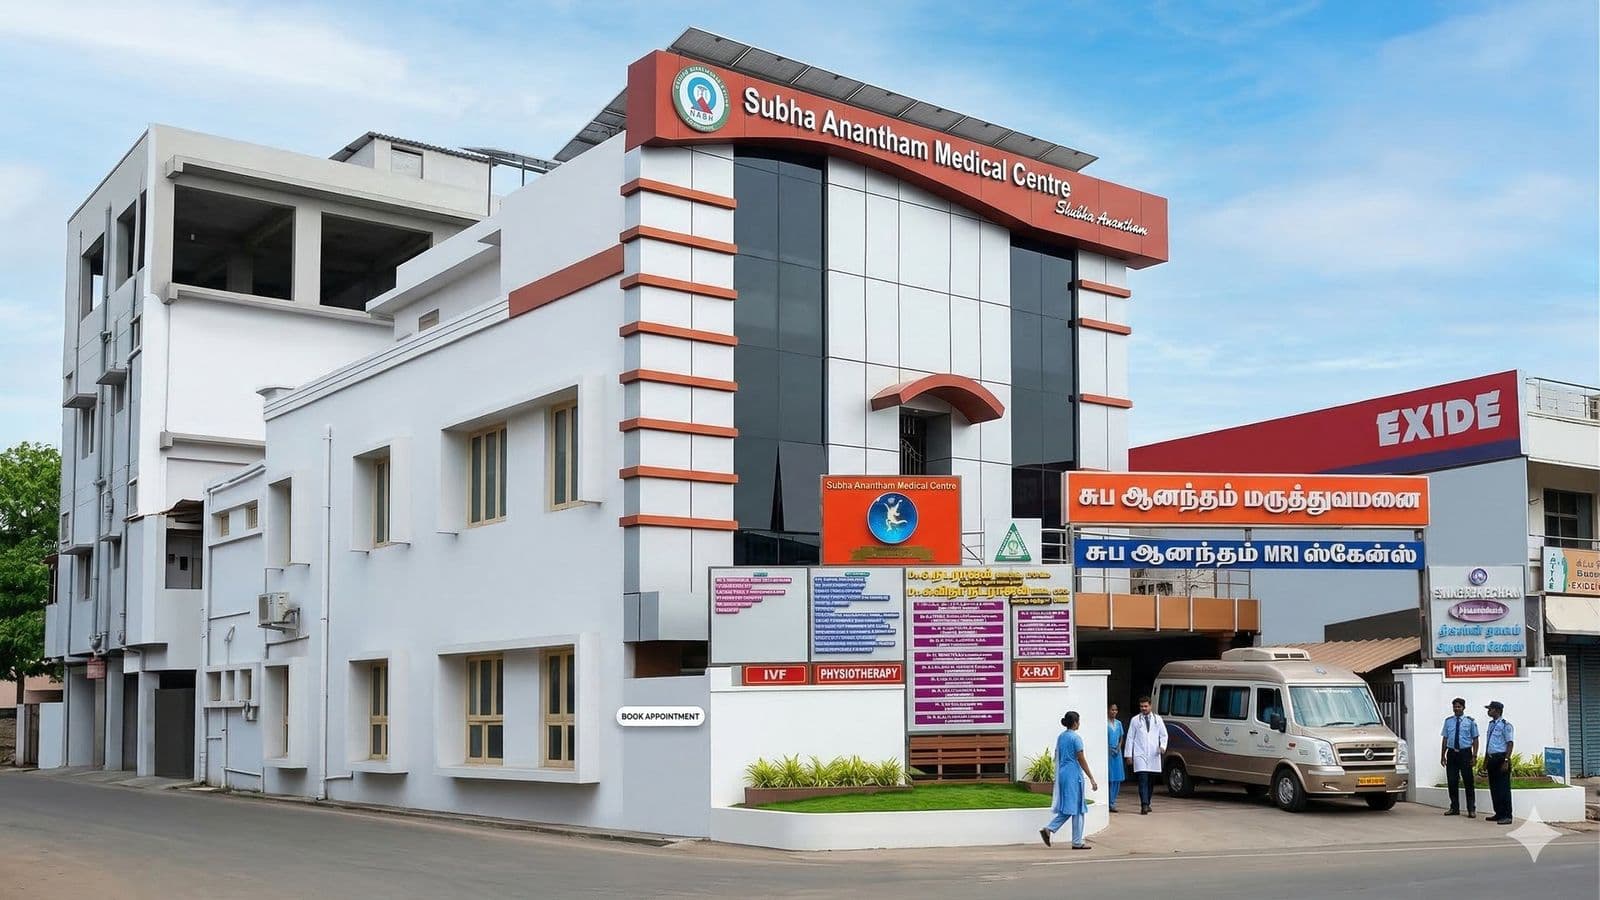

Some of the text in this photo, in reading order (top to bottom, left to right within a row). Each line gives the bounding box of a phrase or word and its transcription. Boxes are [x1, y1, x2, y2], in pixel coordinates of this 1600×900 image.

[744, 87, 816, 131] Subha
[822, 109, 929, 161] Anantham
[935, 139, 1008, 182] Medical
[1012, 162, 1072, 198] Centre
[1055, 200, 1148, 236] Shubha Anantham
[1376, 389, 1502, 448] EXIDE
[826, 481, 957, 490] Subha Anantham Medical Centre
[1079, 482, 1421, 515] சுப ஆனந்தம் மருத்துவமனை
[1086, 542, 1417, 567] சுப ஆனந்தம் MRI ஸ்கேன்ஸ்
[764, 669, 787, 680] IVF
[820, 668, 898, 680] PHYSIOTHERAPY
[1022, 667, 1056, 677] X-RAY
